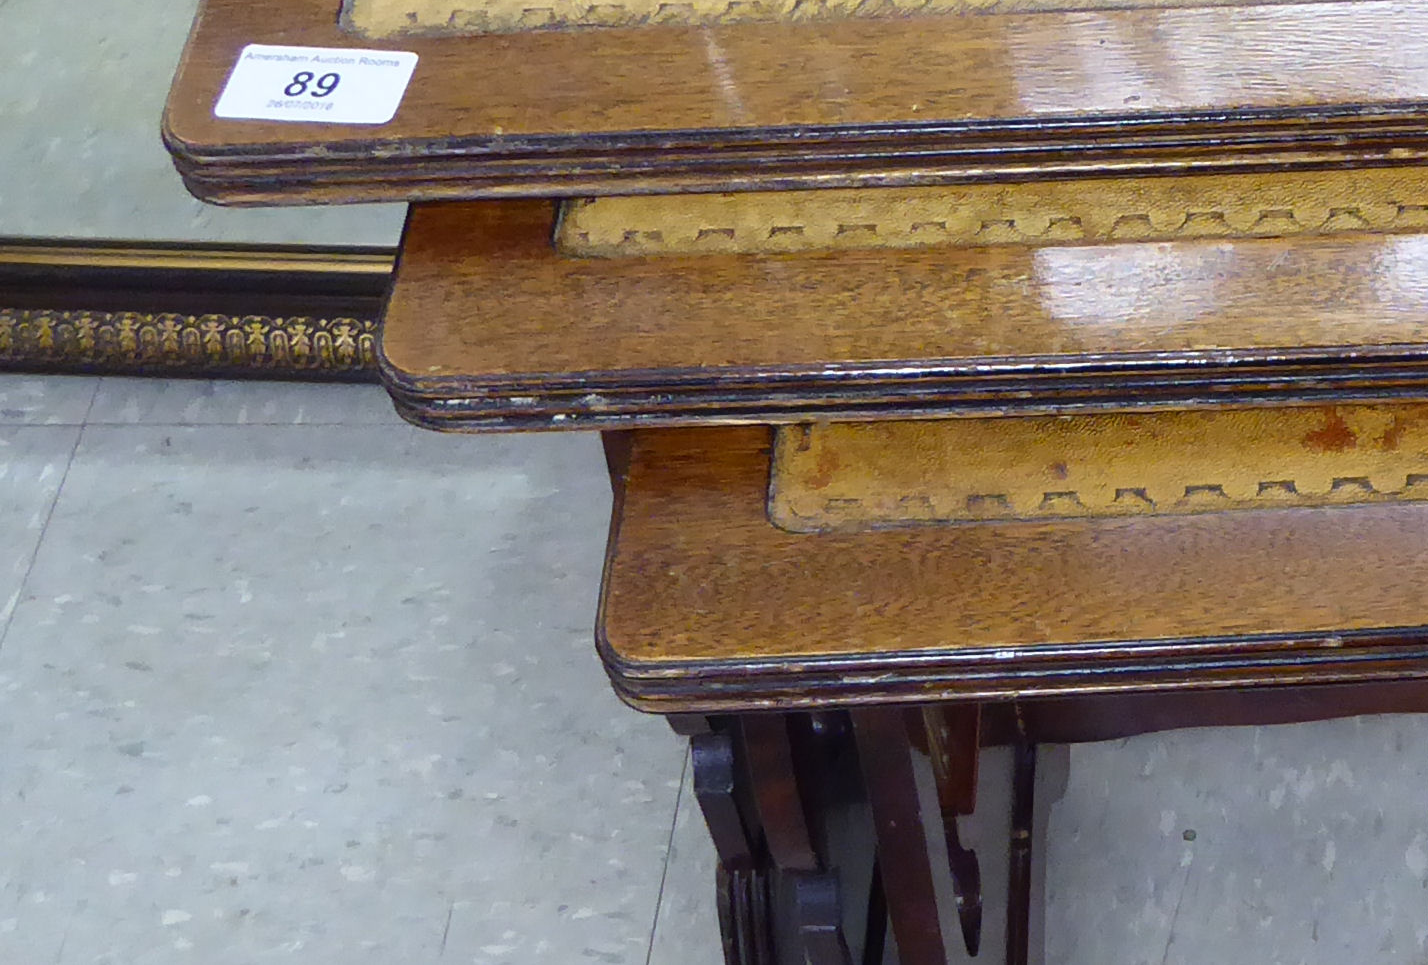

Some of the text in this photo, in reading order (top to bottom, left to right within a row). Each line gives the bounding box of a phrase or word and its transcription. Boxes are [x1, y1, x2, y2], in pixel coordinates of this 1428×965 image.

[245, 52, 400, 67] Amersham Auction Rooms
[284, 71, 340, 98] 89
